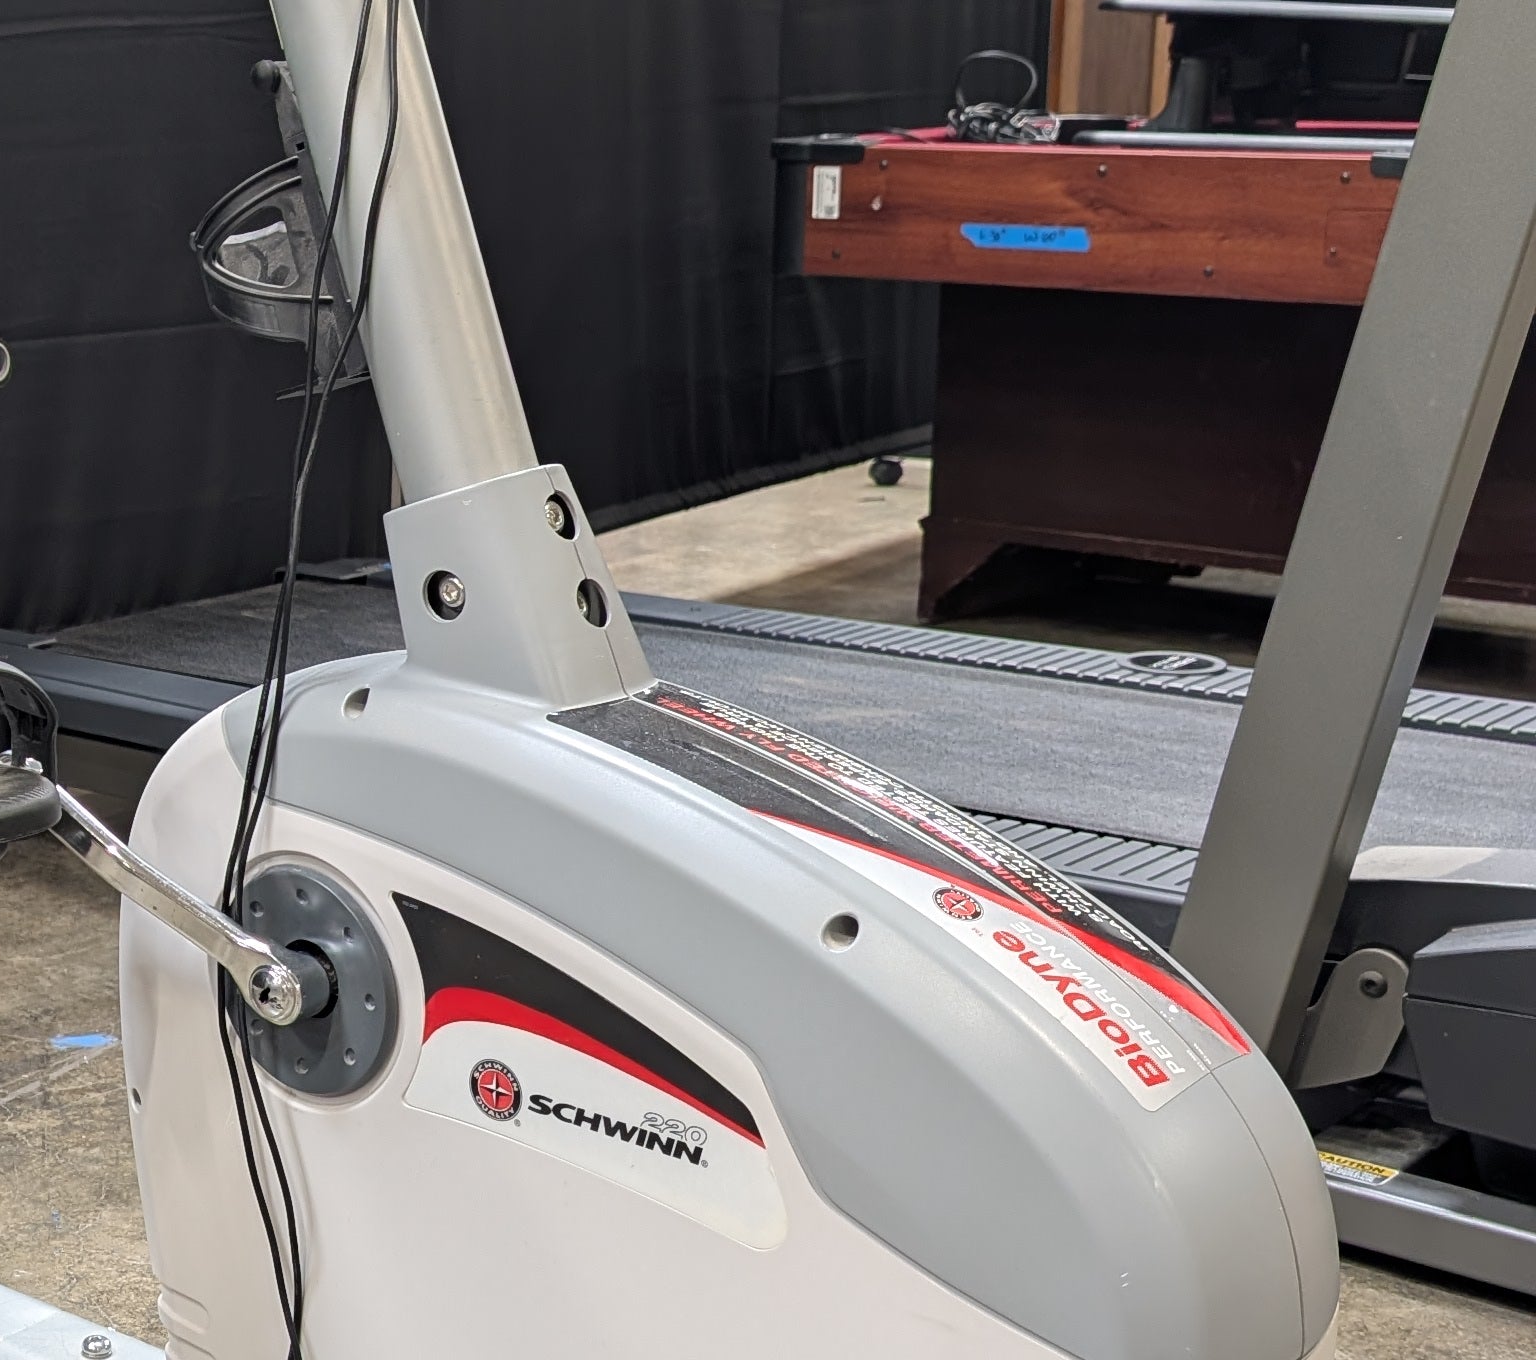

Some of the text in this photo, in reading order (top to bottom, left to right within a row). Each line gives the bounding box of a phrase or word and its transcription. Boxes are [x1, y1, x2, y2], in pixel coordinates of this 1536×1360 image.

[1012, 859, 1104, 923] SCHWINN
[1033, 882, 1081, 916] WITH
[1094, 909, 1149, 951] ROAD
[992, 930, 1170, 1087] BioDyne
[1008, 920, 1186, 1074] PERFORMANCE
[473, 1059, 520, 1093] SCHWINN
[474, 1094, 515, 1120] QUALITY
[527, 1093, 704, 1167] SCHWINN
[639, 1111, 708, 1147] 220
